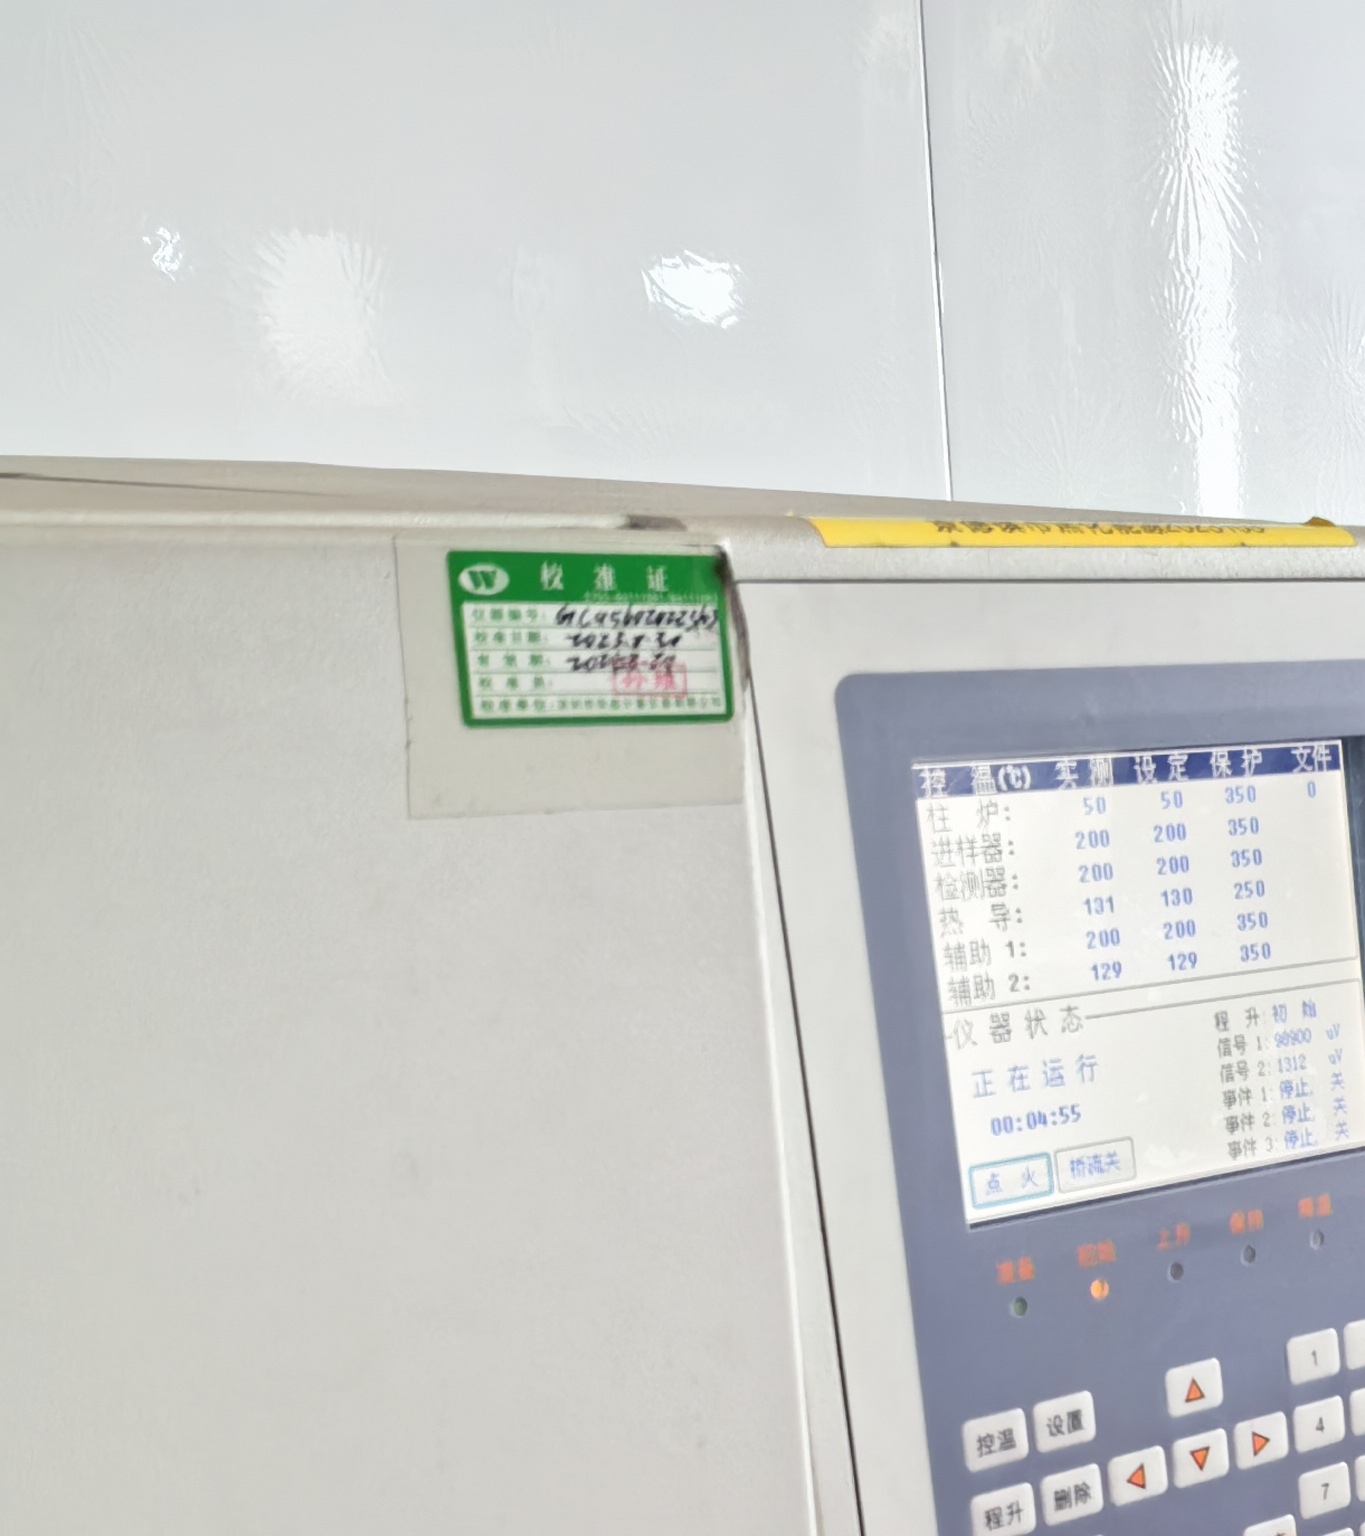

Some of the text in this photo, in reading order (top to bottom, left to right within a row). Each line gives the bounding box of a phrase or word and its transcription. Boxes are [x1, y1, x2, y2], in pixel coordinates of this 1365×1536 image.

[540, 561, 669, 593] 校准证
[1134, 752, 1190, 784] 设定
[1210, 747, 1264, 778] 保护
[1291, 744, 1333, 774] 文件
[1083, 796, 1107, 816] 50
[1160, 790, 1184, 810] 50
[1225, 785, 1257, 804] 350
[1307, 781, 1317, 799] 0
[1075, 830, 1110, 850] 200
[1153, 823, 1187, 843] 200
[1228, 816, 1260, 836] 350
[1078, 863, 1114, 883] 200
[1156, 855, 1190, 876] 200
[1231, 849, 1263, 868] 350
[1084, 895, 1115, 915] 131
[1160, 887, 1193, 908] 130
[1234, 880, 1265, 900] 250
[1086, 928, 1121, 950] 200
[1163, 919, 1197, 940] 200
[1237, 911, 1269, 931] 350
[1091, 961, 1123, 981] 129
[1168, 952, 1198, 971] 129
[1240, 942, 1272, 962] 350
[952, 1004, 1084, 1050] 仪器状态
[971, 1053, 1098, 1098] 正在运行
[991, 1103, 1082, 1136] 00:04:55
[985, 1165, 1039, 1196] 点火
[1311, 1349, 1319, 1367] 1
[1045, 1408, 1086, 1438] 设置
[1314, 1416, 1326, 1434] 4
[976, 1427, 1018, 1459] 控温
[1052, 1480, 1093, 1512] 删除
[1320, 1482, 1331, 1501] 7
[982, 1499, 1025, 1532] 程升
